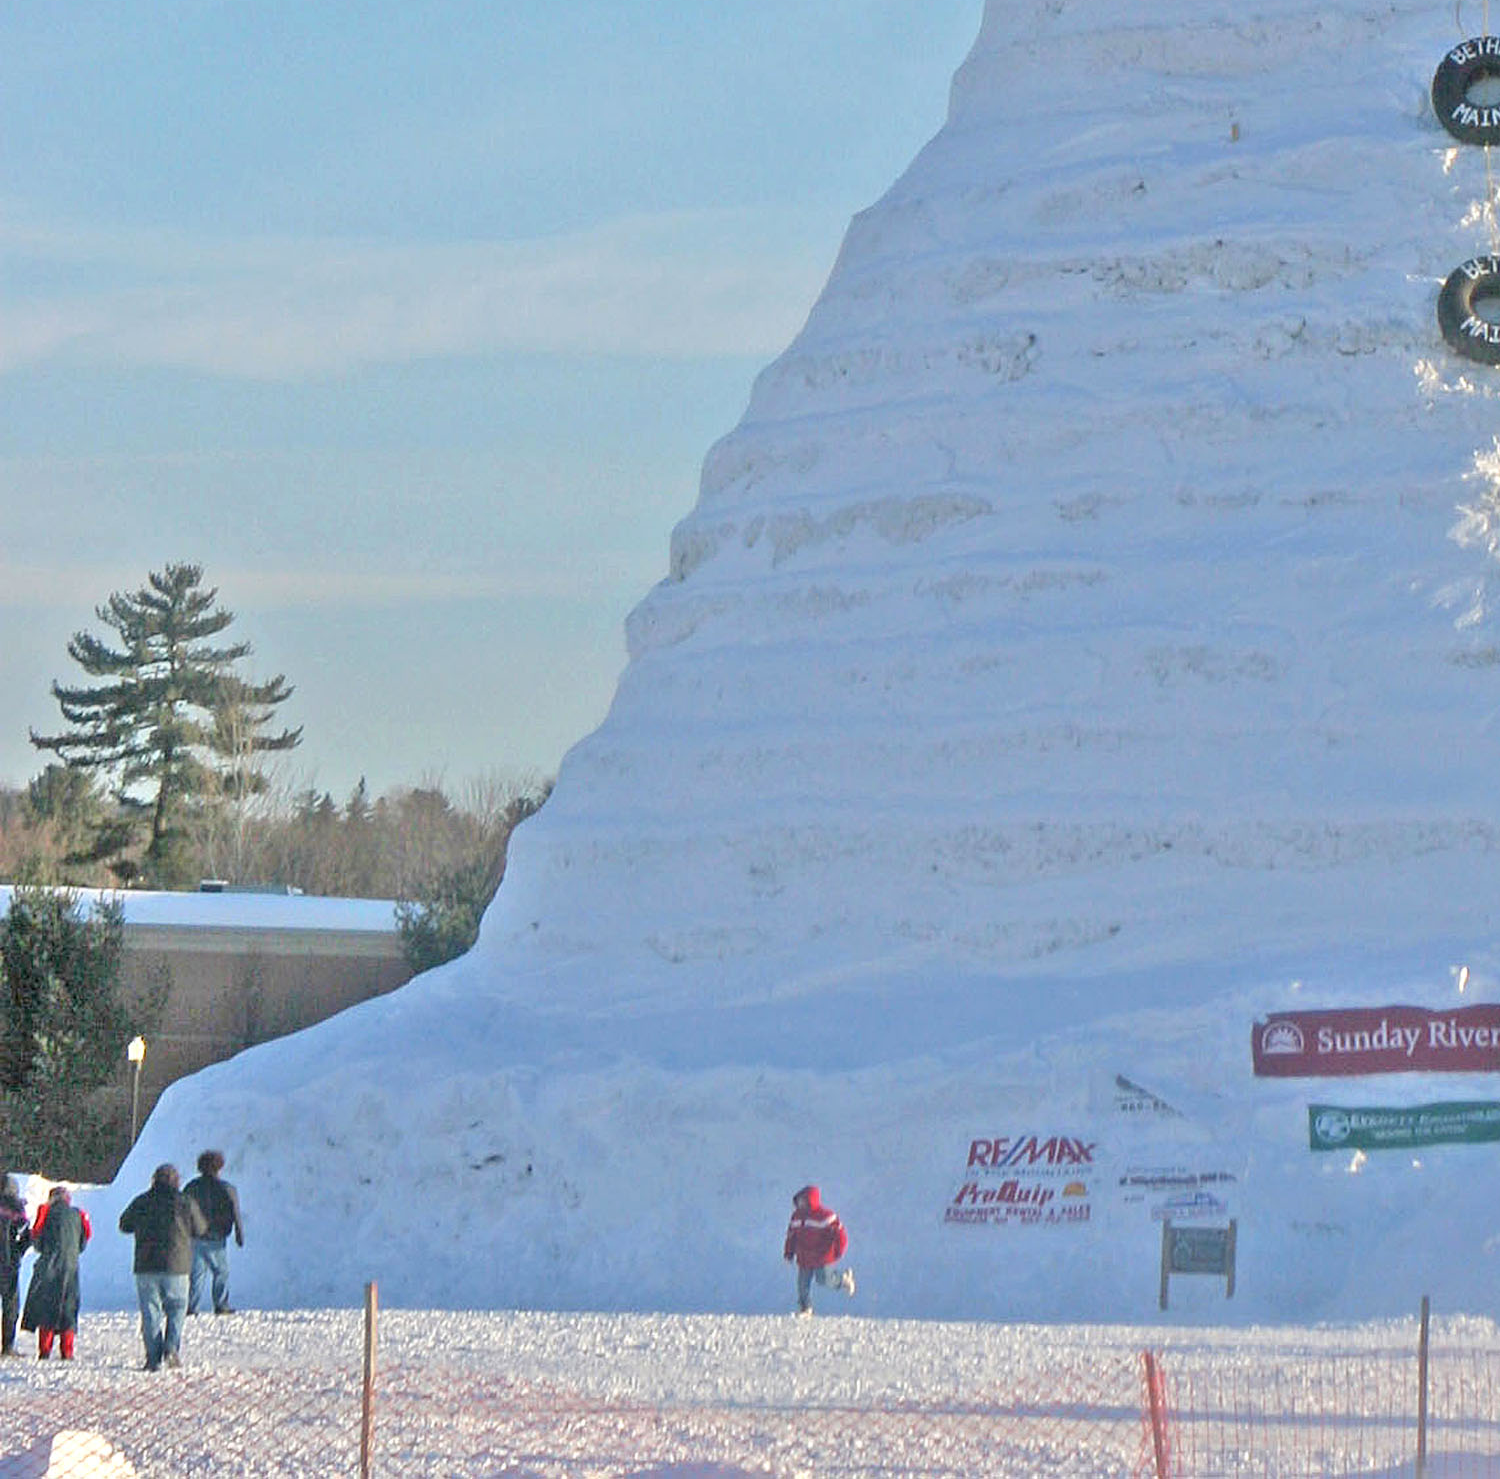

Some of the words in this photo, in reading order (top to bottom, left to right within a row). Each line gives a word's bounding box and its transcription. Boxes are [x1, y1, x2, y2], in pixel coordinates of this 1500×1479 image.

[1317, 1020, 1420, 1057] Sunday
[967, 1135, 1097, 1167] RE/MAX
[954, 1178, 1055, 1207] ProQuip
